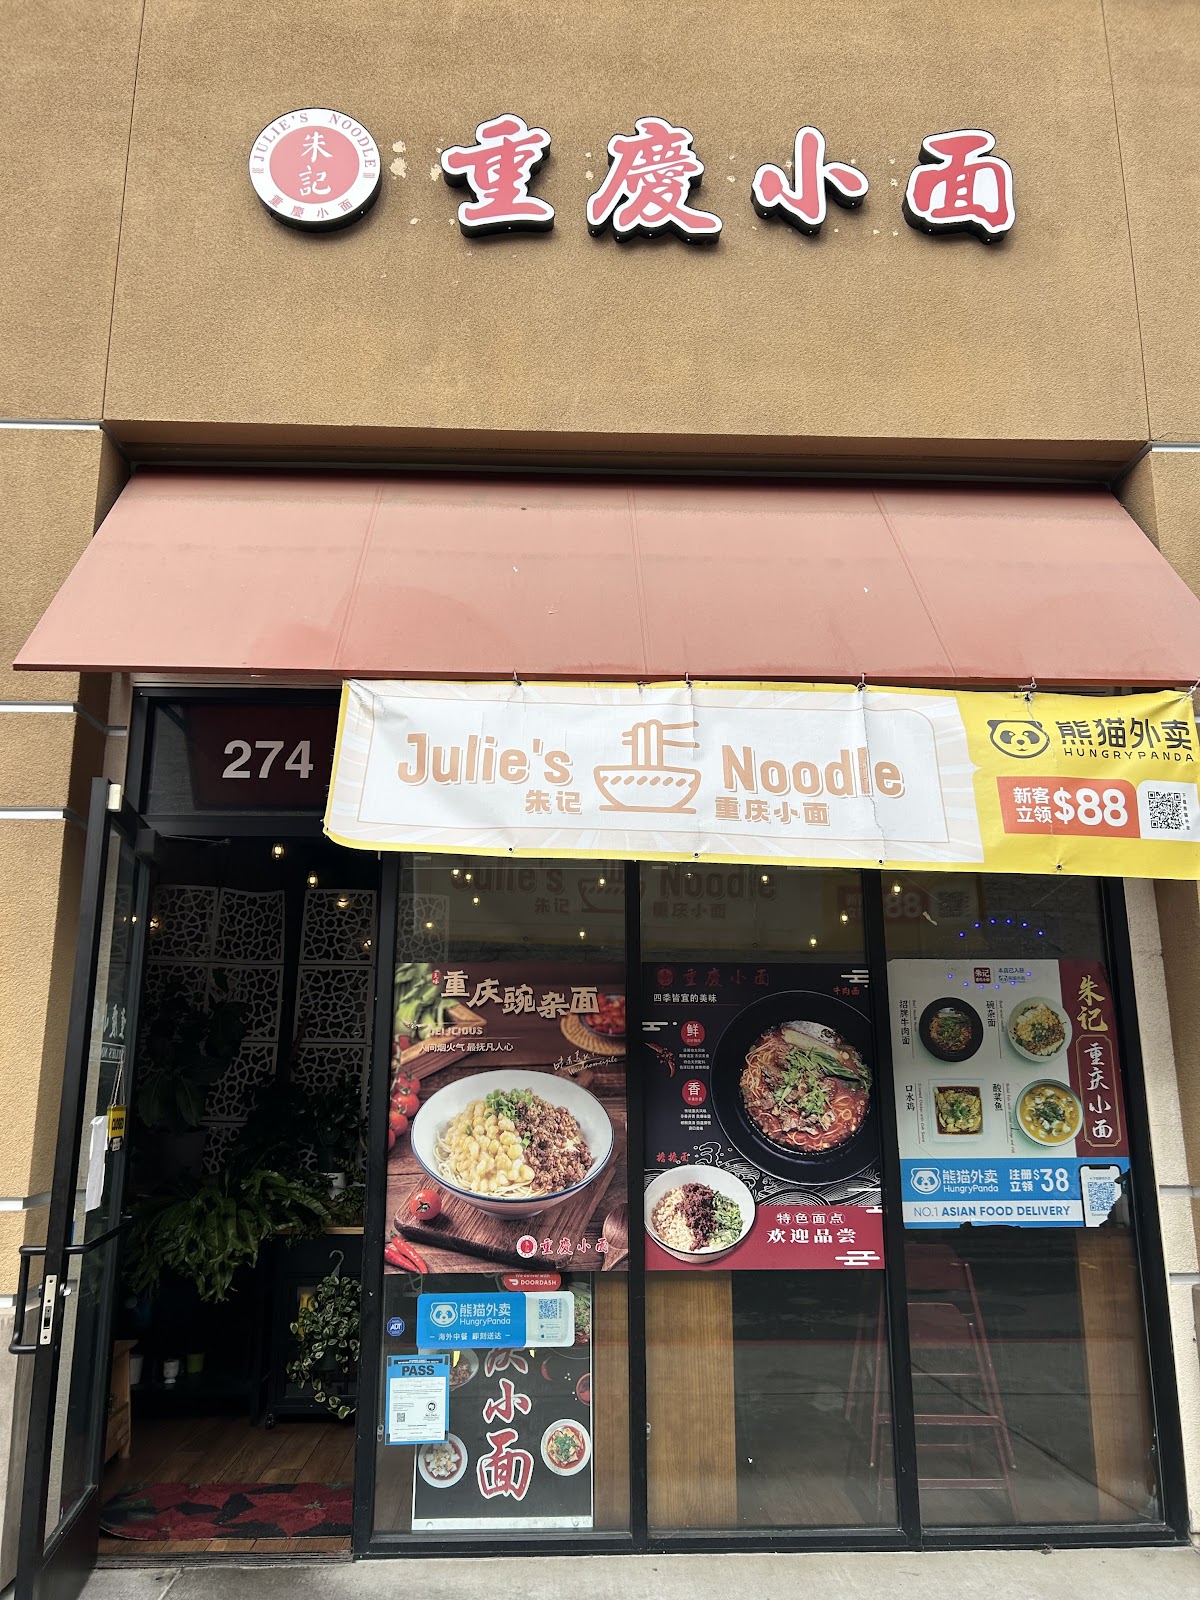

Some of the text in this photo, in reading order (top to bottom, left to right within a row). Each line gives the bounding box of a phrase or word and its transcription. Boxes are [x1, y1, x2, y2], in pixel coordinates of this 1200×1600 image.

[253, 112, 377, 168] JULIE'S NOODLE
[298, 131, 333, 197] 朱記
[441, 113, 1016, 241] 重慶小面
[1055, 717, 1193, 751] 熊猫外卖
[222, 739, 314, 779] 274
[1063, 747, 1194, 762] HUNGRYPANDA
[397, 732, 906, 800] Julie's Noodle
[1013, 787, 1051, 805] 新客
[524, 788, 832, 826] 朱记 重庆小面
[1053, 786, 1129, 826] $88
[1015, 805, 1053, 825] 立领
[653, 993, 718, 1003] 四季皆宜的美味
[832, 986, 860, 996] 牛肉面
[1077, 974, 1109, 1031] 朱记
[686, 1023, 700, 1037] 鲜
[688, 1082, 701, 1096] 香
[1083, 1042, 1113, 1139] 重庆小面
[905, 1084, 916, 1111] 口水鸡
[942, 1168, 998, 1184] 熊猫外卖
[1033, 1167, 1070, 1192] $38
[943, 1184, 999, 1194] HungryPanda
[1009, 1180, 1034, 1192] 立领
[776, 1212, 844, 1225] 特色面点
[914, 1205, 1071, 1217] NO.1 ASIAN FOOD DELIVERY
[766, 1228, 857, 1244] 欢迎品尝
[539, 1237, 610, 1256] 重慶小面
[459, 1302, 511, 1317] 熊猫外卖
[390, 1322, 402, 1331] ADT
[459, 1317, 511, 1327] HungryPanda
[438, 1333, 468, 1342] 海外中餐
[401, 1364, 435, 1376] PASS
